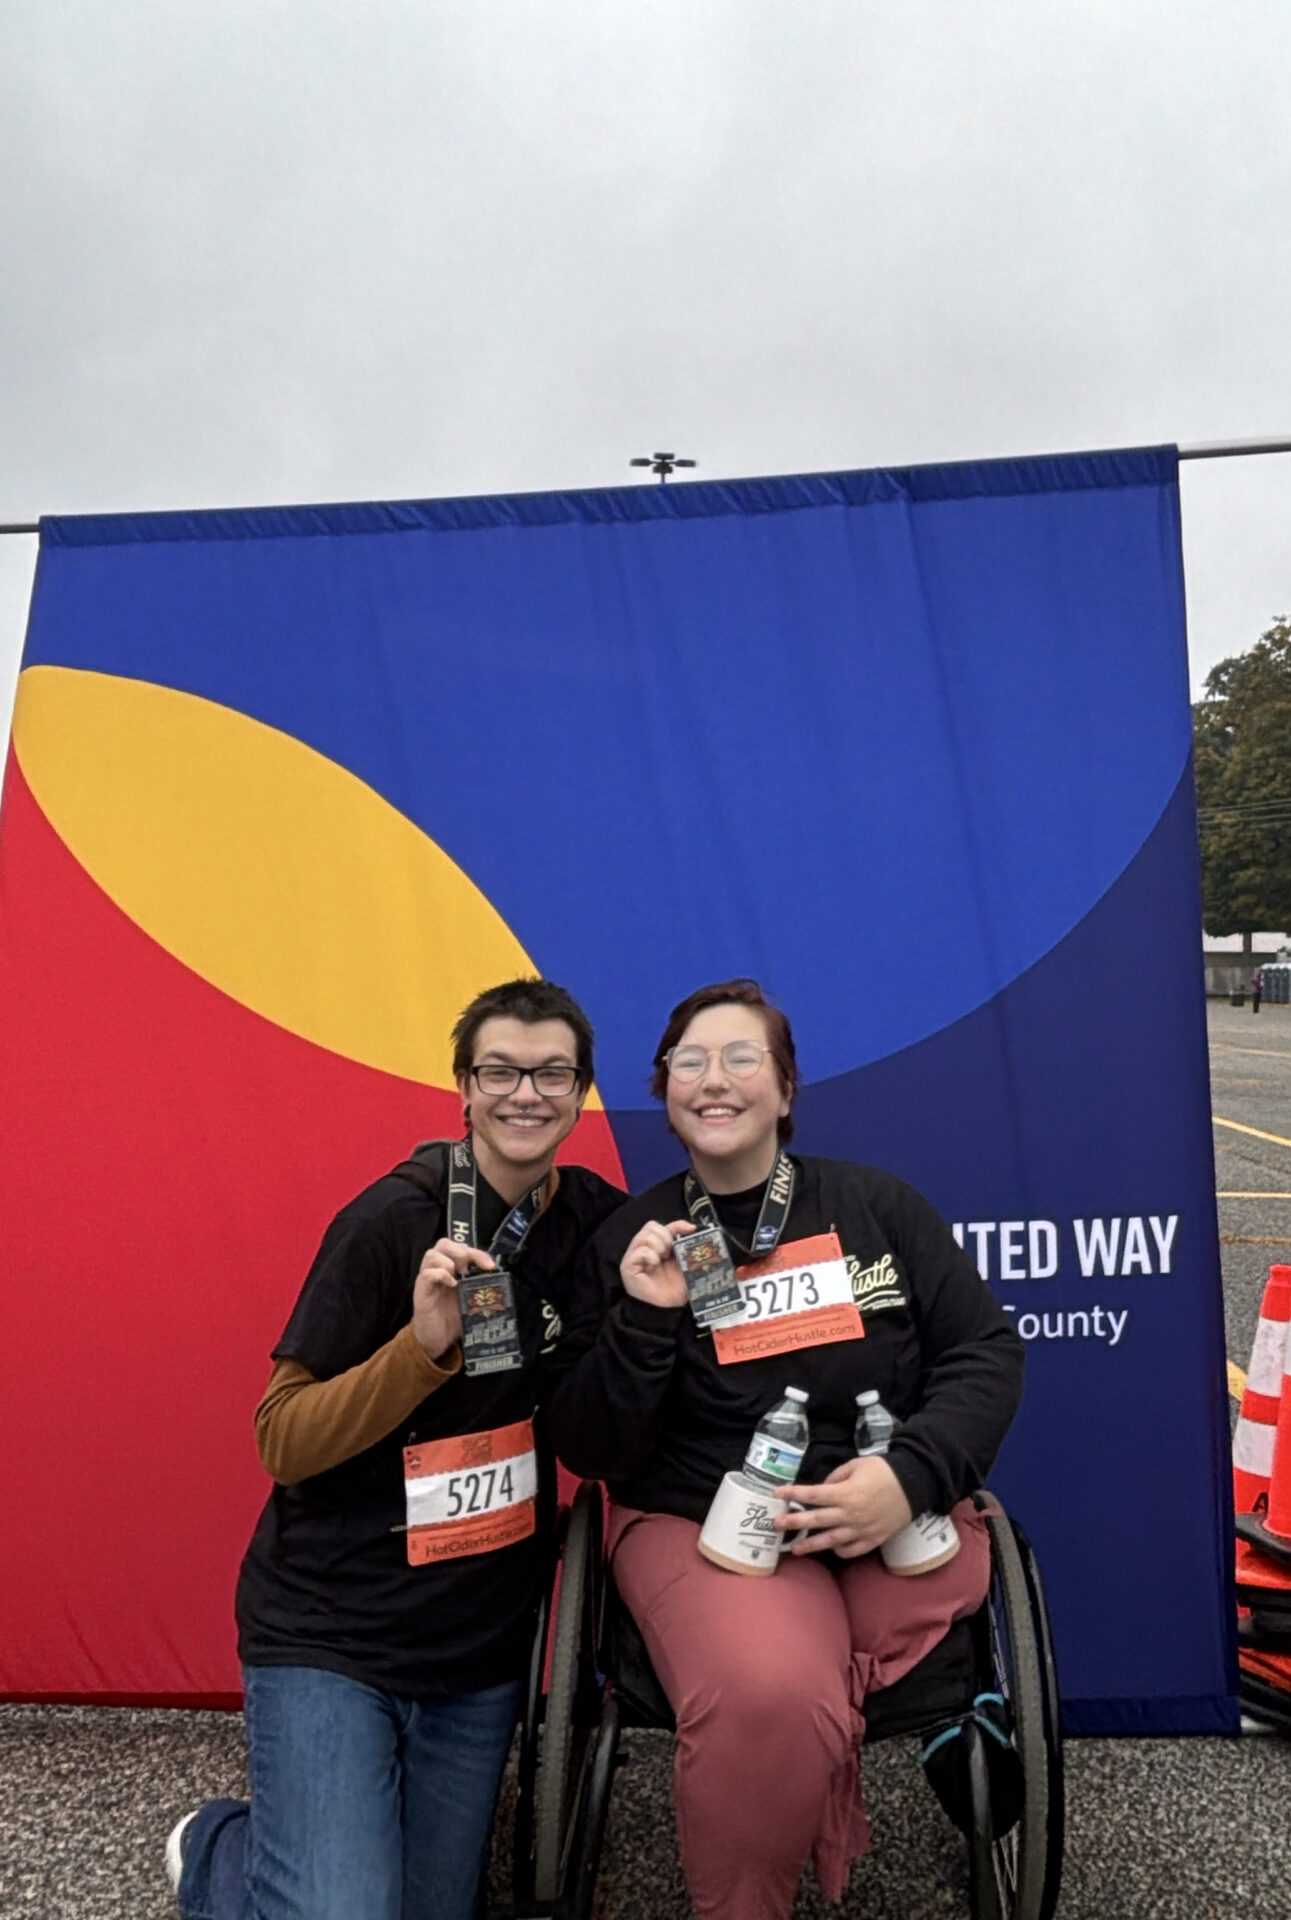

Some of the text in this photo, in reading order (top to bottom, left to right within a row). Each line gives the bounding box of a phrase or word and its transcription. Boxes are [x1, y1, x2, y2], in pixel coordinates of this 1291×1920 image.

[1073, 1215, 1179, 1278] WAY
[744, 1271, 820, 1320] 5273
[734, 1323, 857, 1356] HotCiderHustle.com
[1001, 1304, 1129, 1347] ounty
[446, 1464, 515, 1518] 5274
